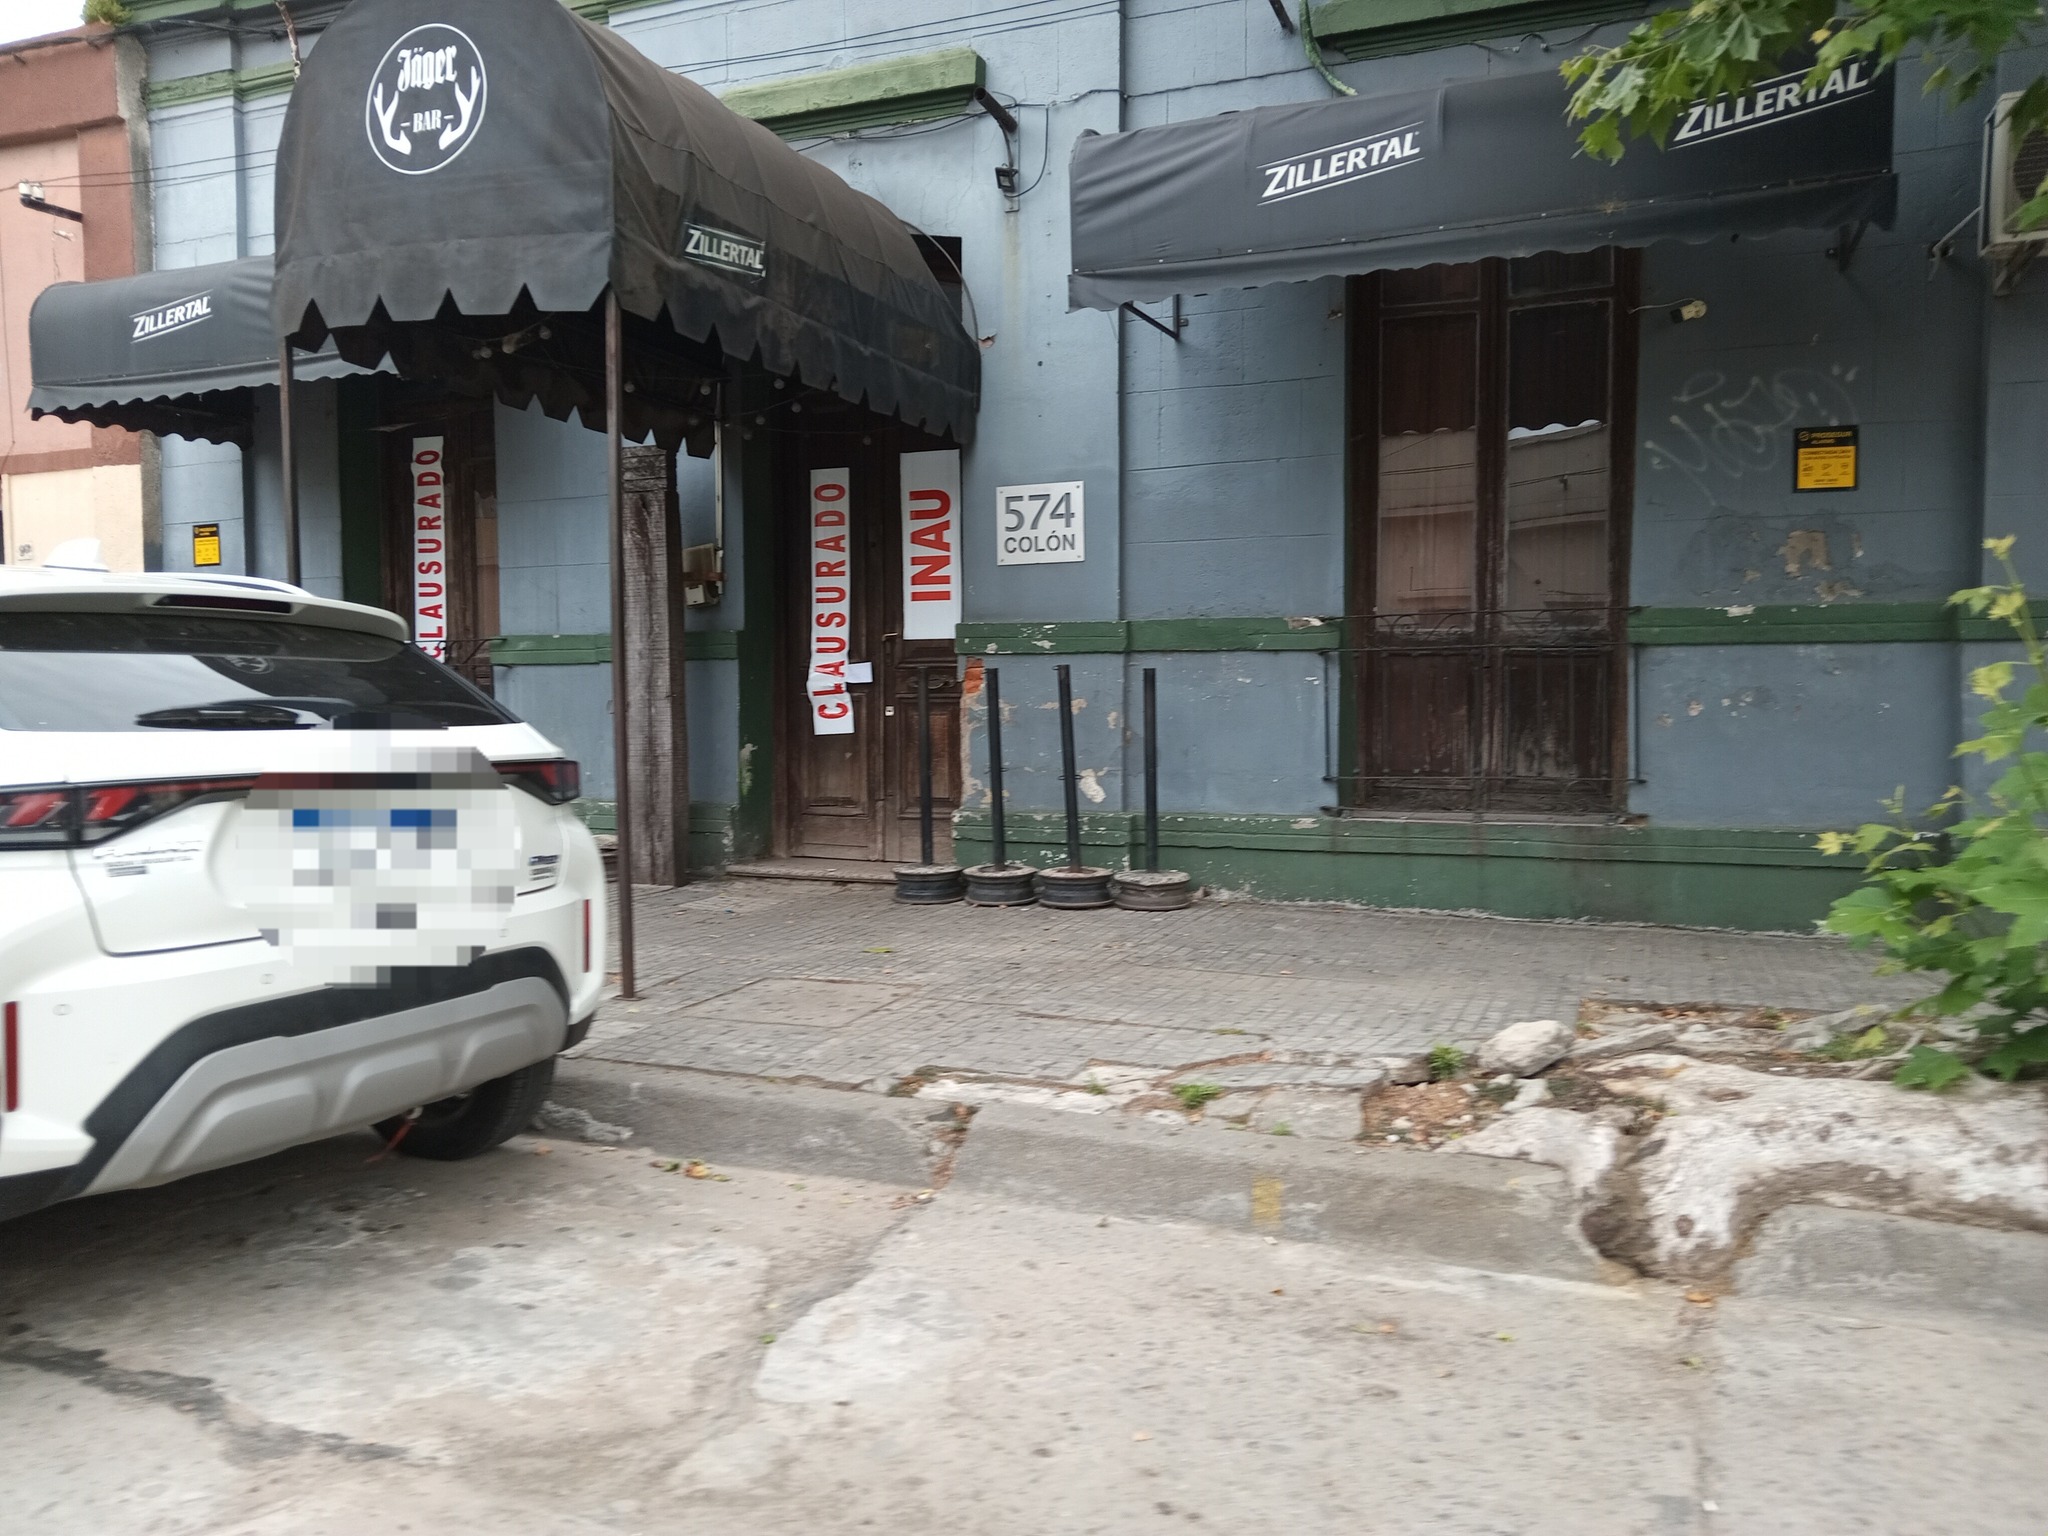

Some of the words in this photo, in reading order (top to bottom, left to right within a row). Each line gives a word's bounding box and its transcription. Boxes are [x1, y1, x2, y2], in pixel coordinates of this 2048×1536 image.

[397, 45, 458, 92] Jäger
[412, 109, 442, 133] BAR
[1673, 61, 1869, 142] ZILLERTAL
[1261, 132, 1421, 198] ZILLERTAL
[684, 228, 764, 269] ZILLERTAL
[132, 296, 211, 338] ZILLERTAL
[1004, 492, 1075, 532] 574
[908, 489, 951, 602] INAU
[1004, 530, 1075, 554] COLÓN
[812, 483, 850, 719] CLAUSURADO
